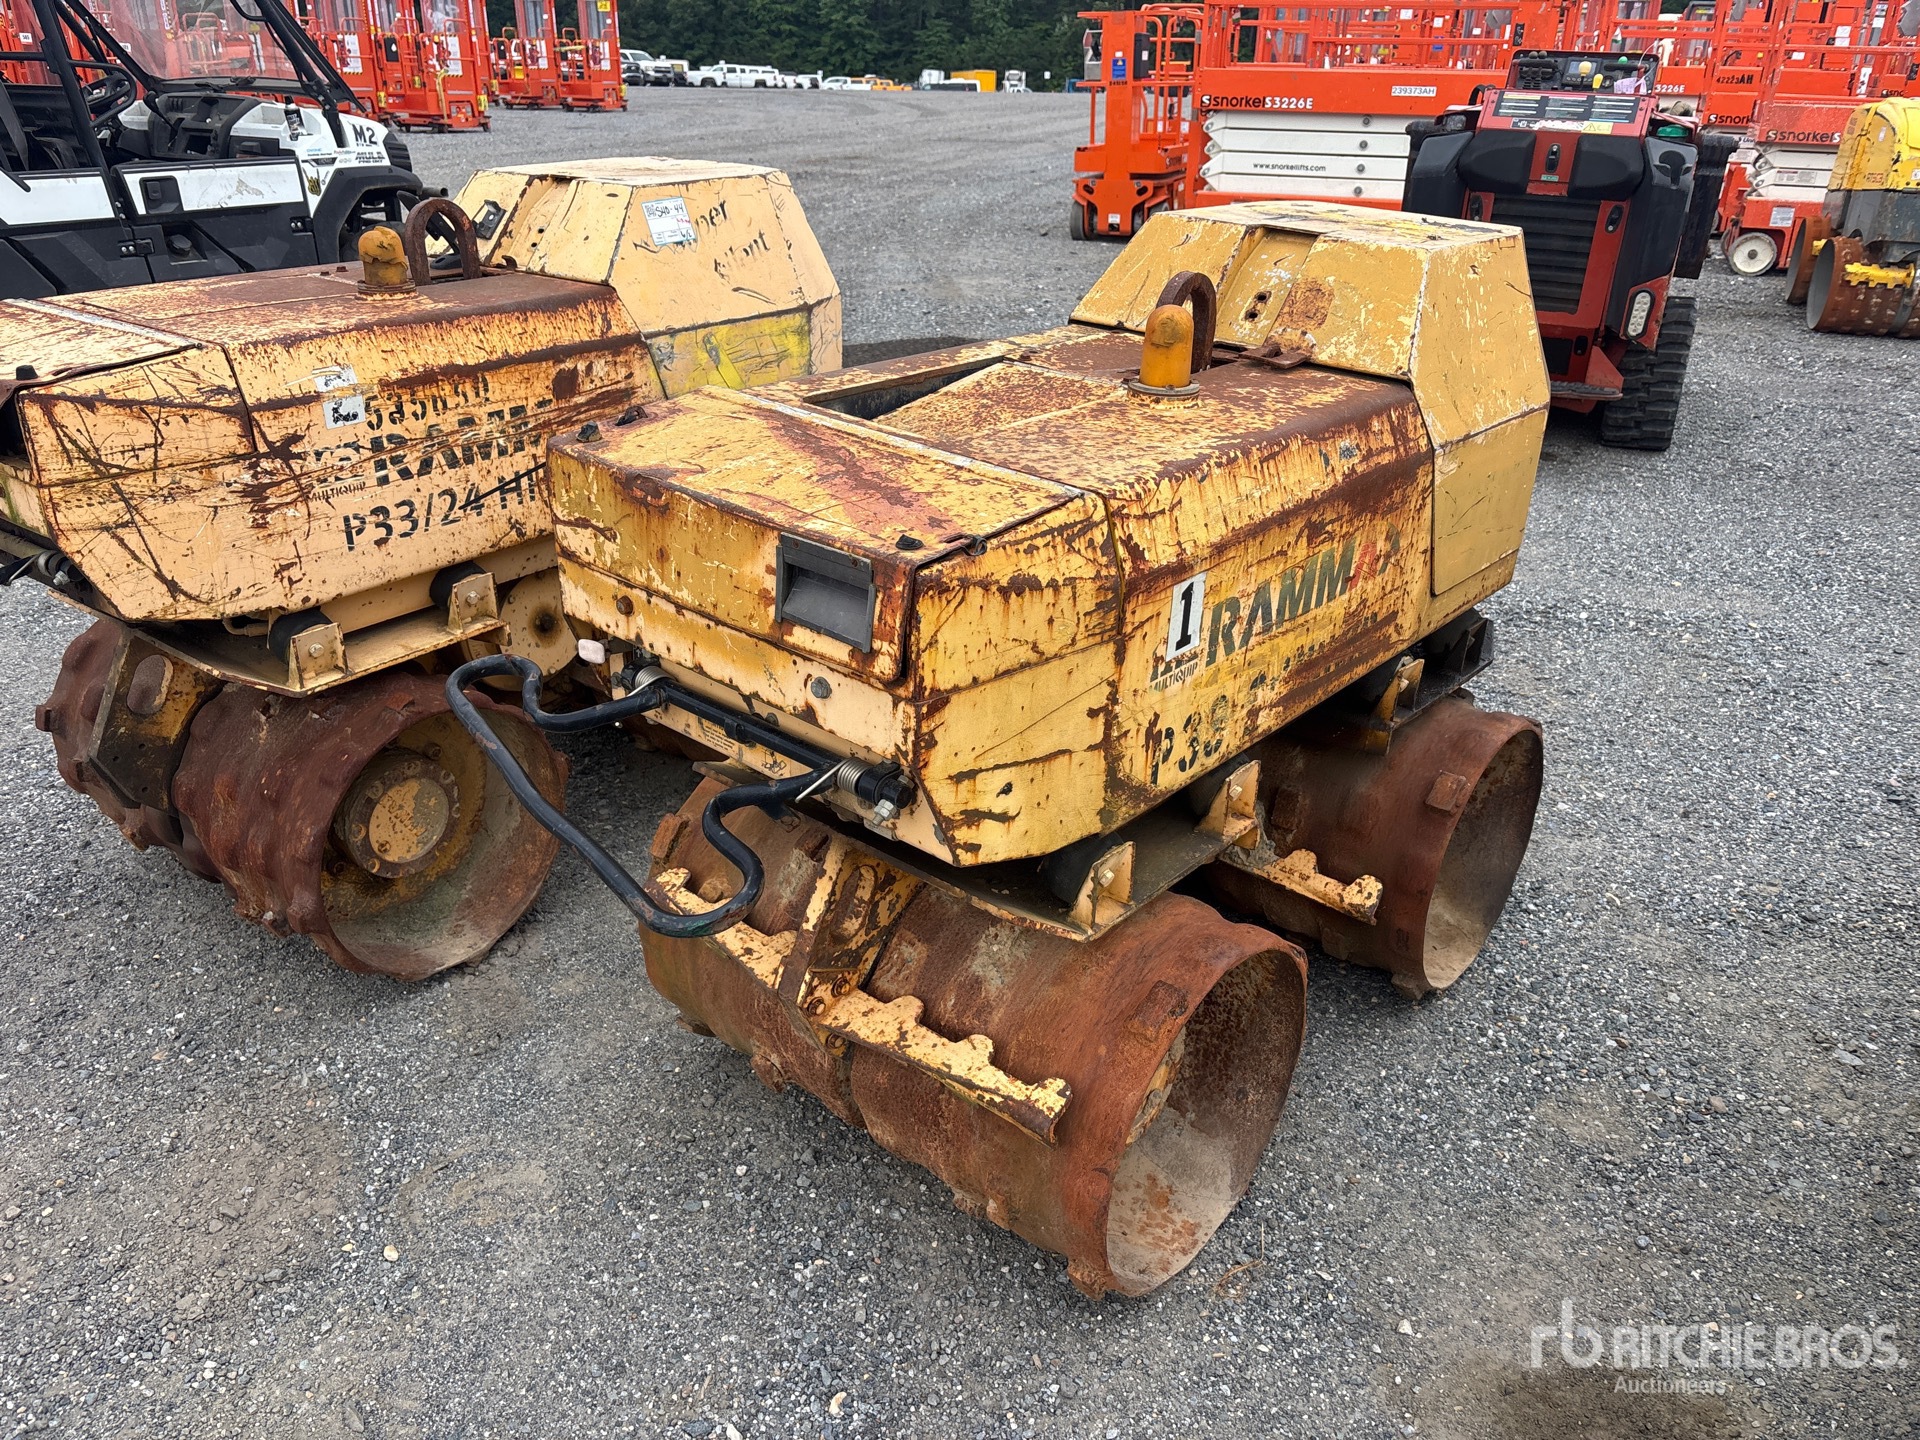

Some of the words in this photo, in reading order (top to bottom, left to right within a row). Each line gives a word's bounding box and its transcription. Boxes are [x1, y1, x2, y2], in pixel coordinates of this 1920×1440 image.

[1392, 86, 1436, 96] 239373AH
[1213, 95, 1264, 109] snorkel
[1264, 96, 1314, 110] S3226E
[352, 123, 378, 146] M2
[1175, 581, 1195, 652] 1
